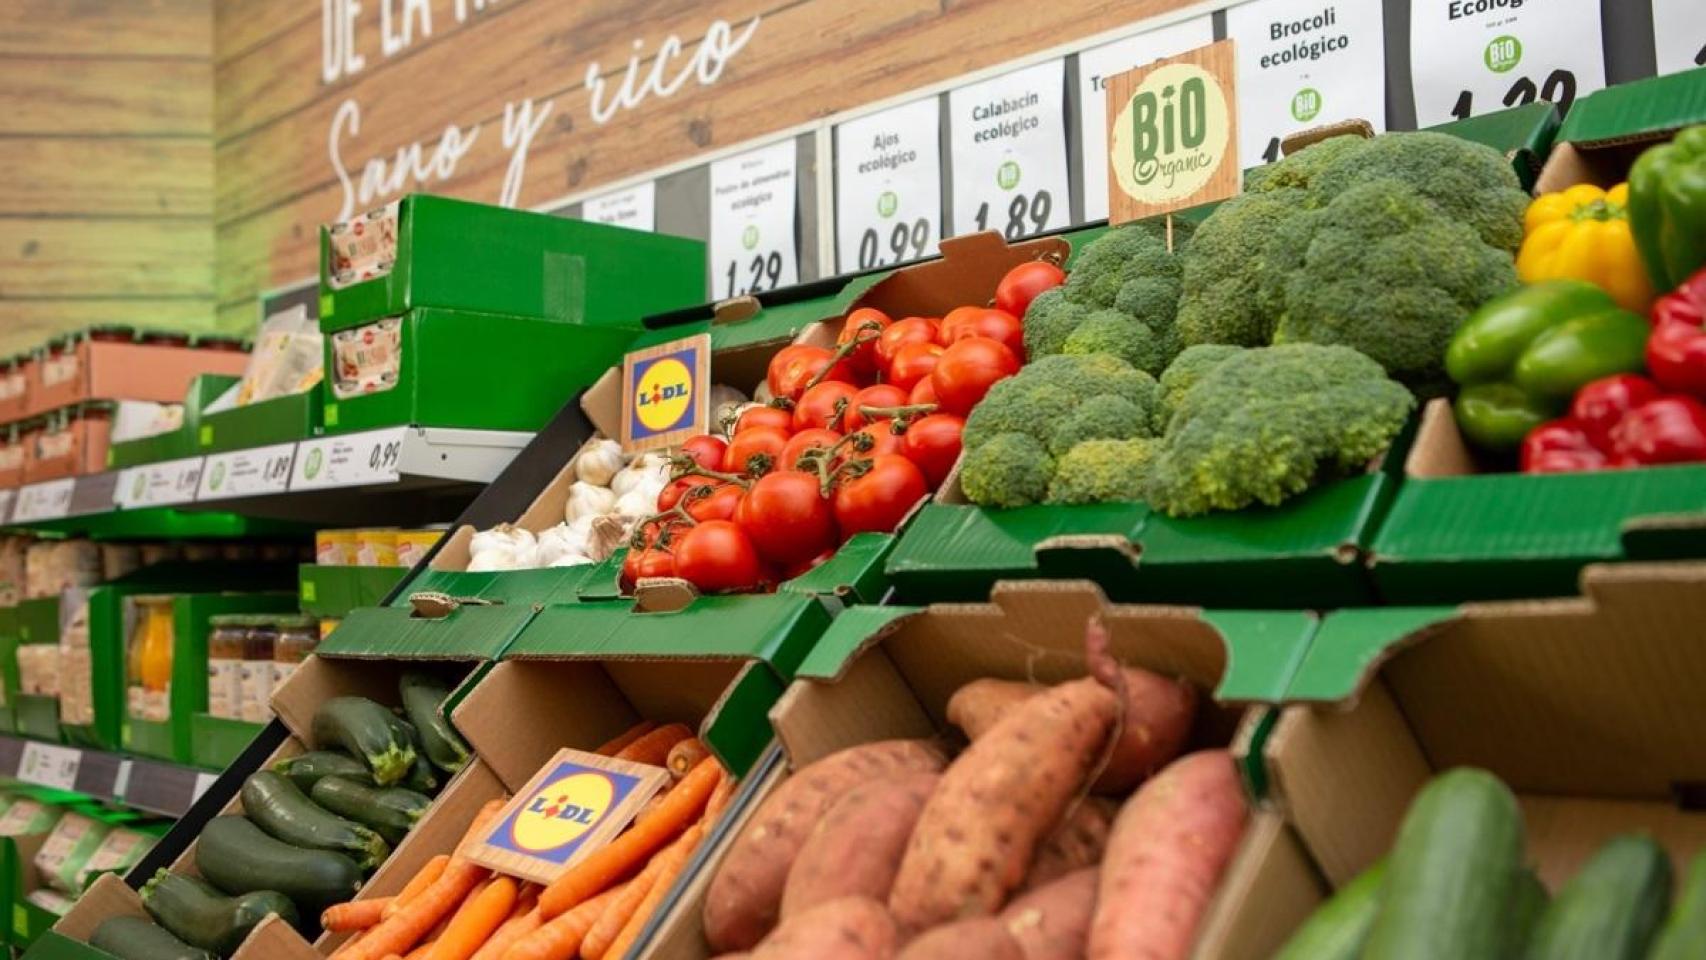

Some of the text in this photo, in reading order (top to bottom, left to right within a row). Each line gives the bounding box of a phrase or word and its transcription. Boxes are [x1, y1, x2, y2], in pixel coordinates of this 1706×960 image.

[1270, 7, 1336, 41] Brocoli
[1260, 34, 1349, 68] ecológico
[329, 15, 761, 224] Sano y rico
[974, 115, 1039, 143] ecológico
[873, 133, 899, 150] Ajos
[369, 441, 400, 471] 0,99
